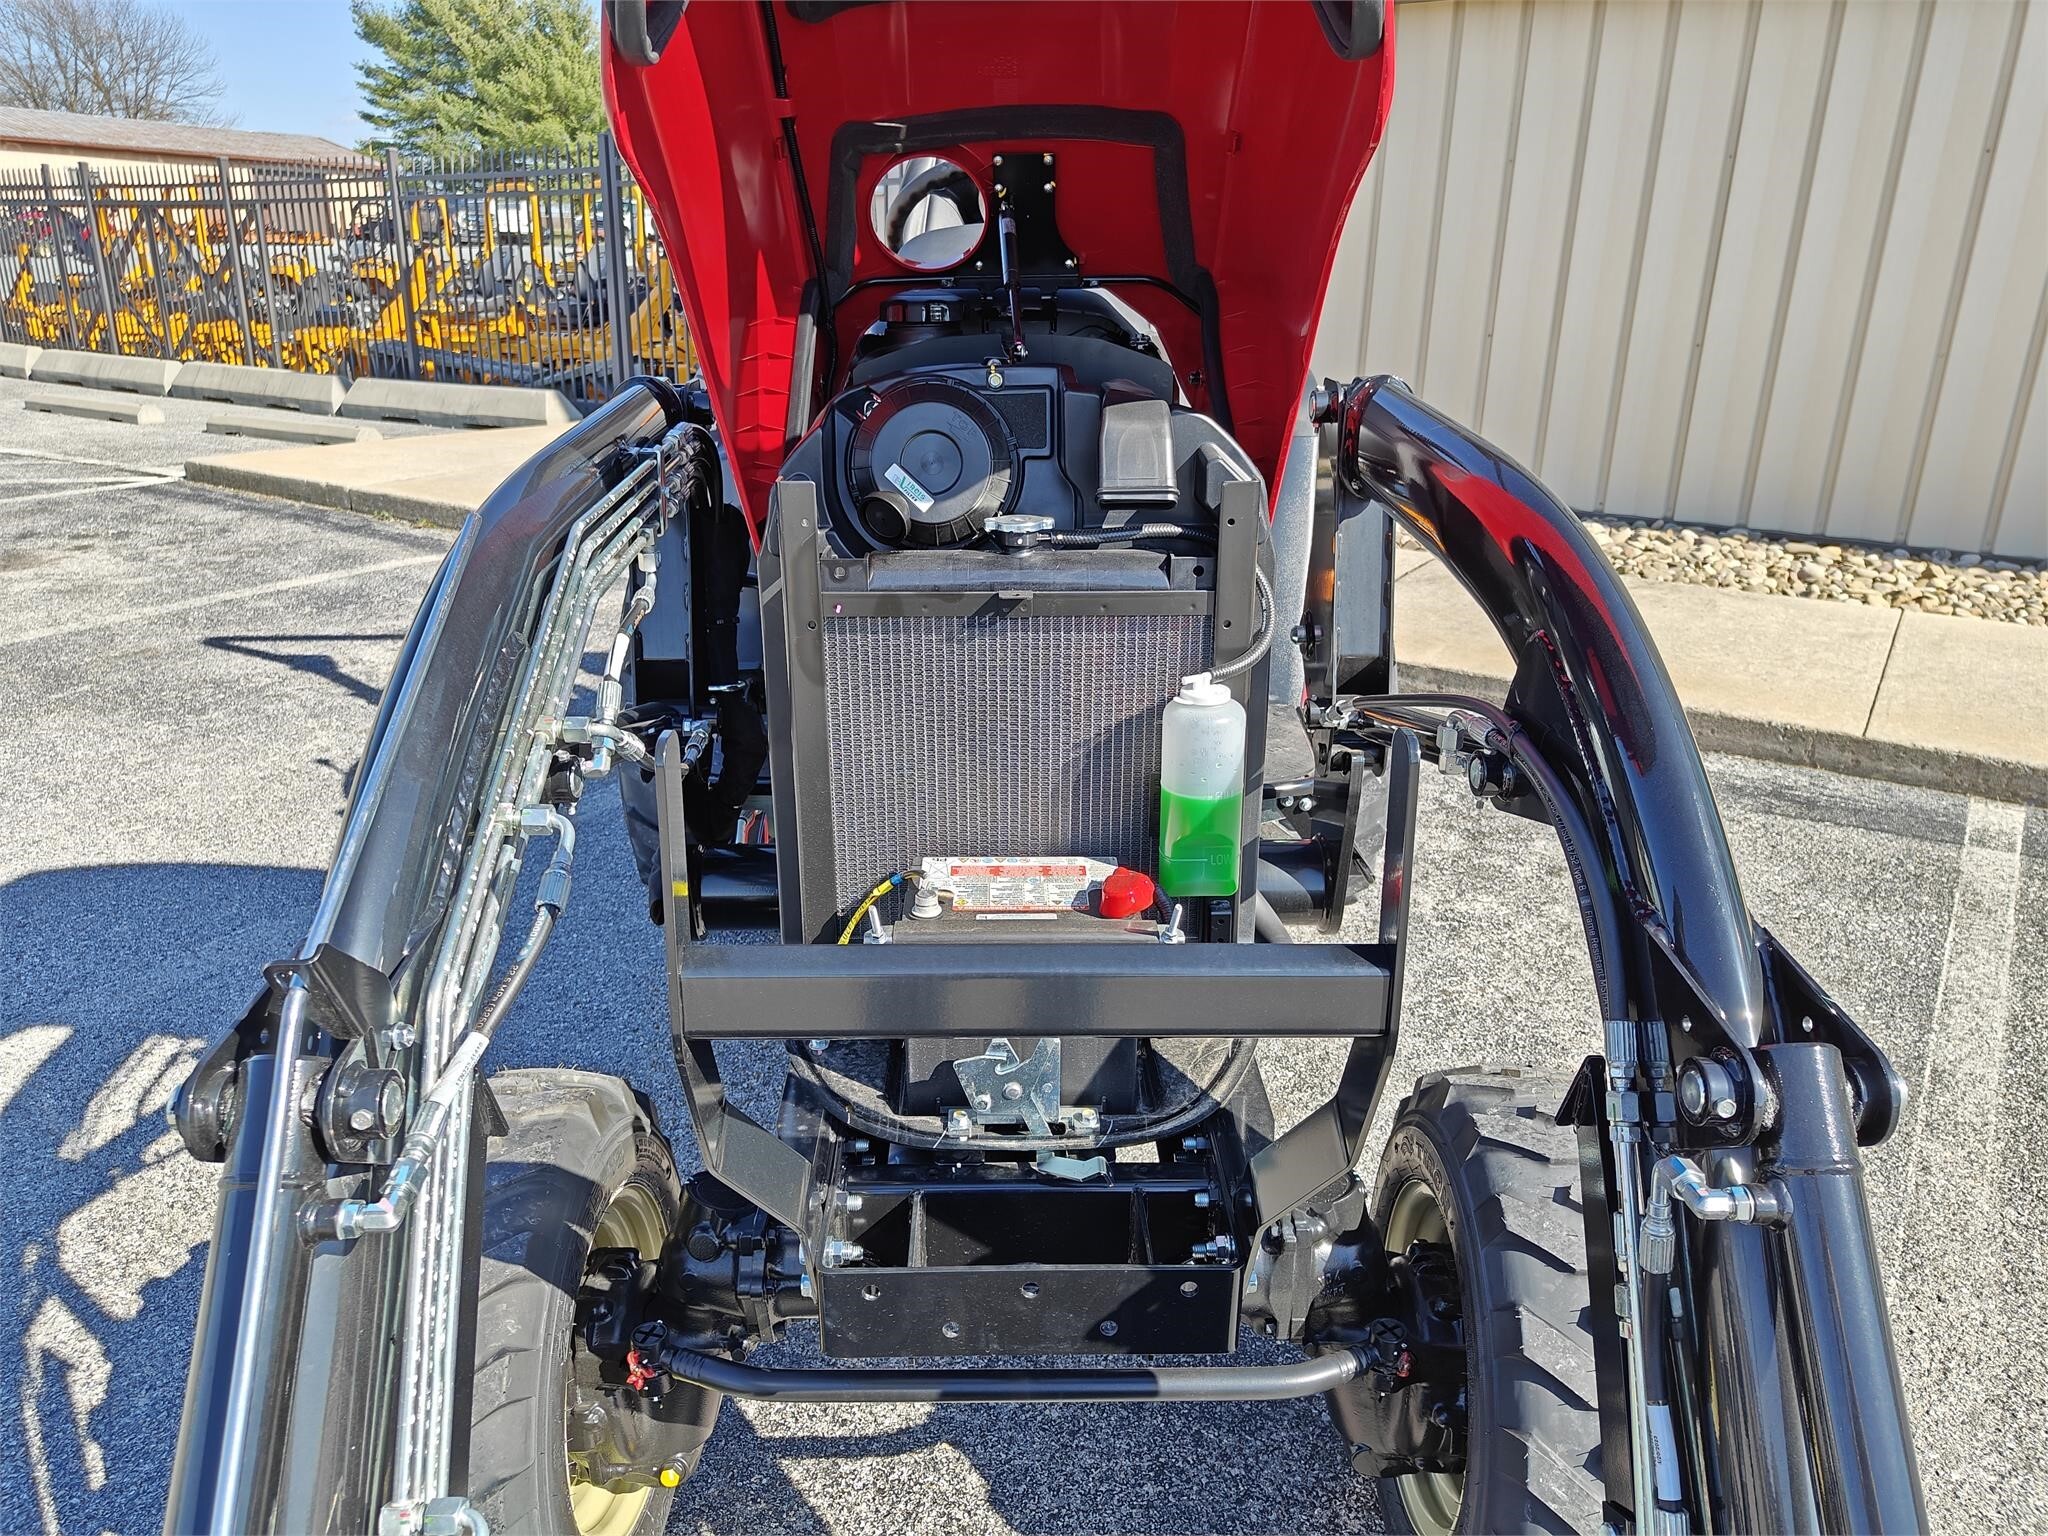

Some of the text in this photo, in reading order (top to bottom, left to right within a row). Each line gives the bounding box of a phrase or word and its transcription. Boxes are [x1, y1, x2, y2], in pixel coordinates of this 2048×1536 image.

[1210, 853, 1232, 866] LOW
[1573, 863, 1586, 886] Type
[1584, 909, 1597, 936] Flame
[1590, 938, 1605, 977] Resistant
